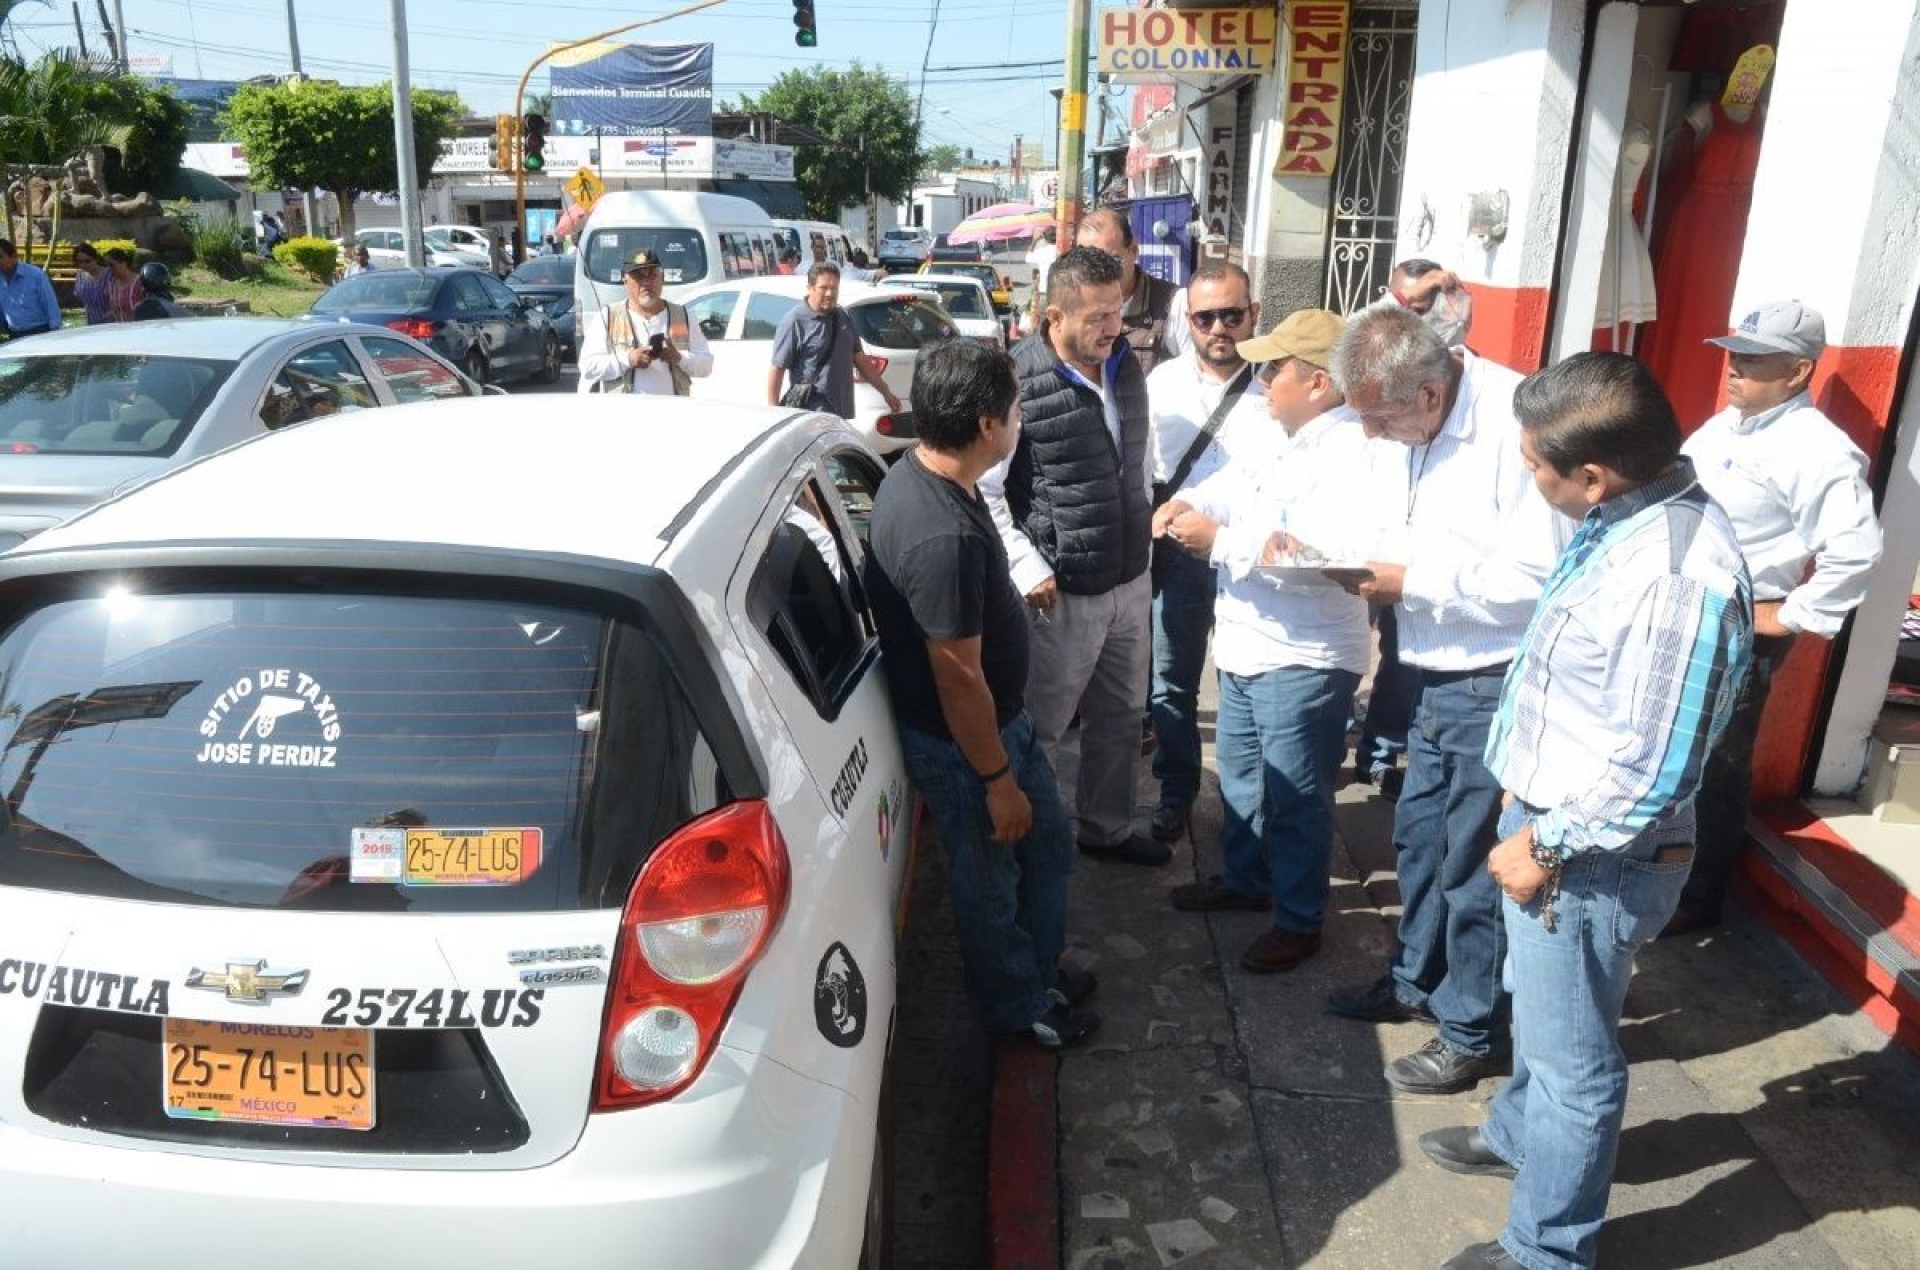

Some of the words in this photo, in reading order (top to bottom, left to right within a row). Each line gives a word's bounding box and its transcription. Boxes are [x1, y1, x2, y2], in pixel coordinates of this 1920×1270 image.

[1104, 12, 1272, 46] HOTEL
[1111, 48, 1263, 70] COLONIAL
[551, 85, 617, 97] Bienvenidos
[619, 87, 666, 97] Terminal
[669, 87, 712, 98] Cuautla
[1280, 6, 1346, 173] ENTRADA
[200, 677, 253, 738] SITIO
[259, 669, 291, 689] DE
[296, 672, 341, 742] TAXIS
[197, 741, 253, 764] JOSE
[257, 743, 337, 768] PERDIZ
[408, 837, 520, 873] 25-74-LUS
[0, 958, 170, 1015] CUAUTLA
[321, 988, 545, 1028] 2574LUS
[220, 1022, 315, 1039] MORELOS
[171, 1043, 366, 1099] 25-74-LUS
[169, 1095, 185, 1107] 17
[239, 1096, 297, 1113] MÉXICO
